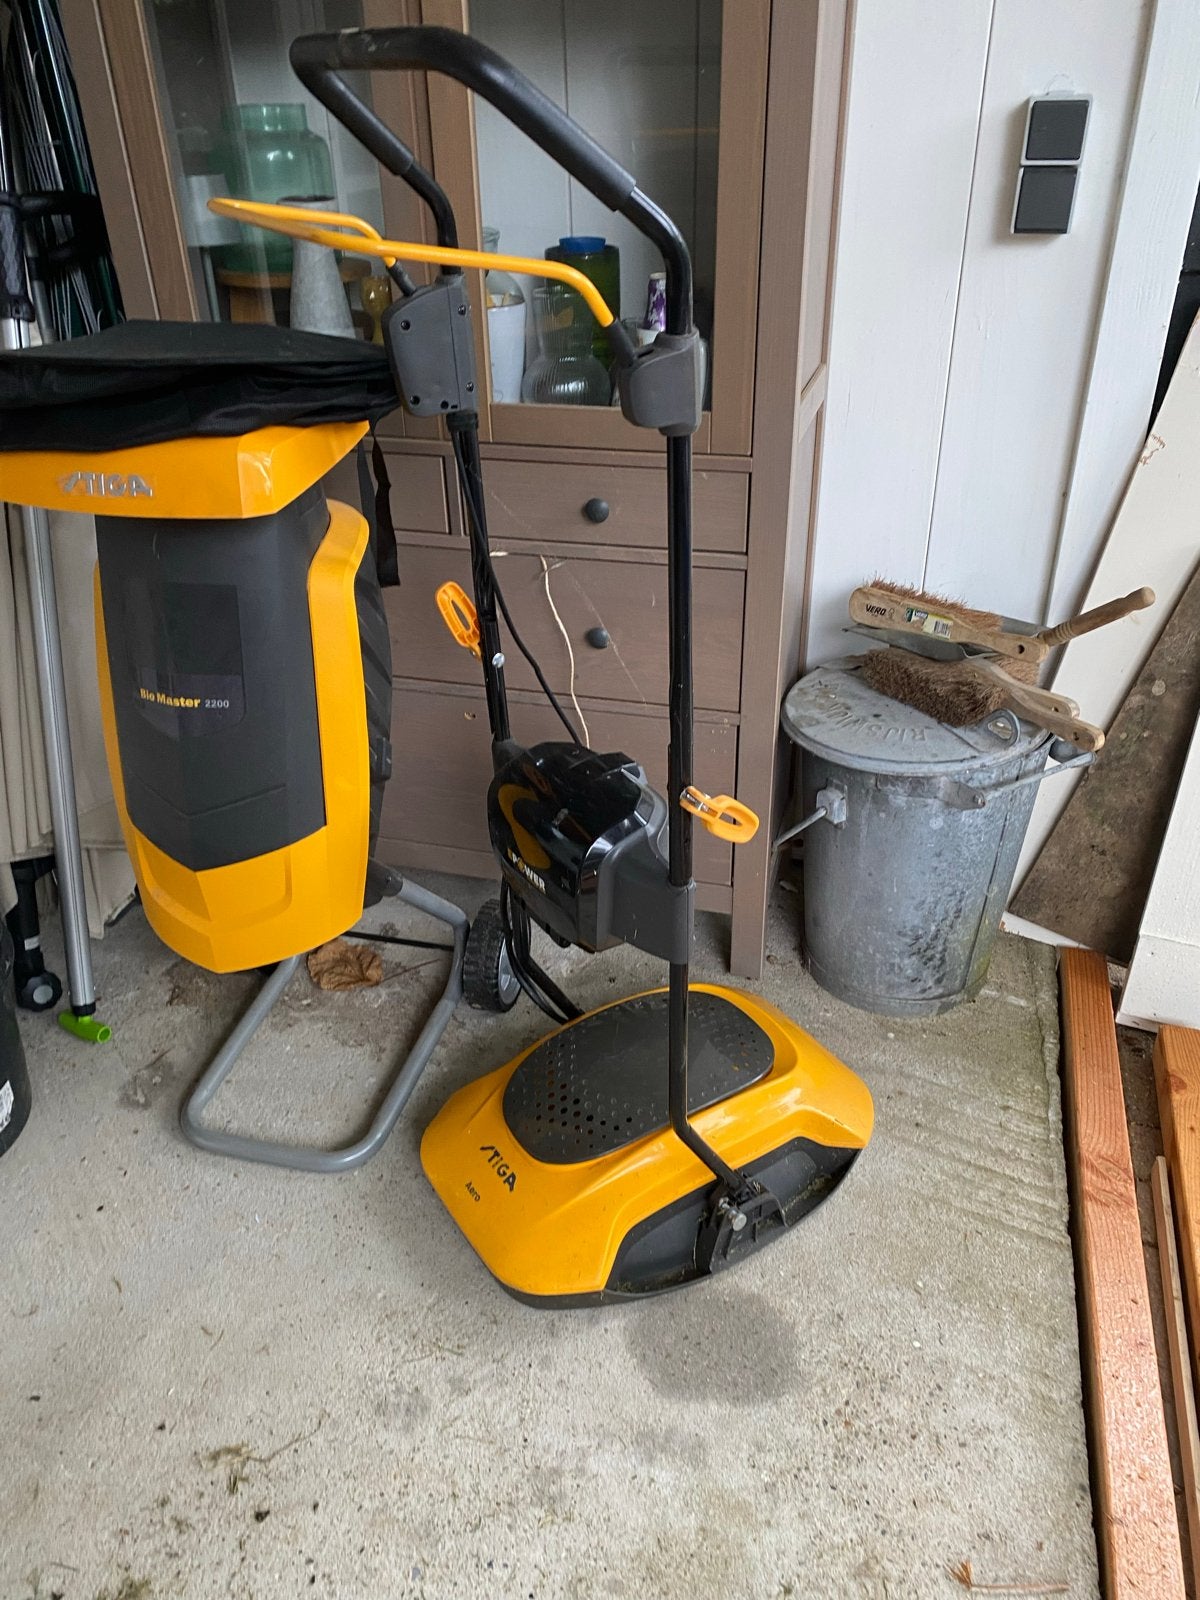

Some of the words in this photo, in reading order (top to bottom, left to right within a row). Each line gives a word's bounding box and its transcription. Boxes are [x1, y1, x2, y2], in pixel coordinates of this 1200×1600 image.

[64, 471, 154, 497] STIGA
[865, 604, 887, 616] VERO
[140, 688, 155, 702] Bio
[156, 693, 201, 708] Master
[204, 699, 230, 709] 2200
[479, 1145, 517, 1192] STIGA
[465, 1181, 481, 1202] Aero
